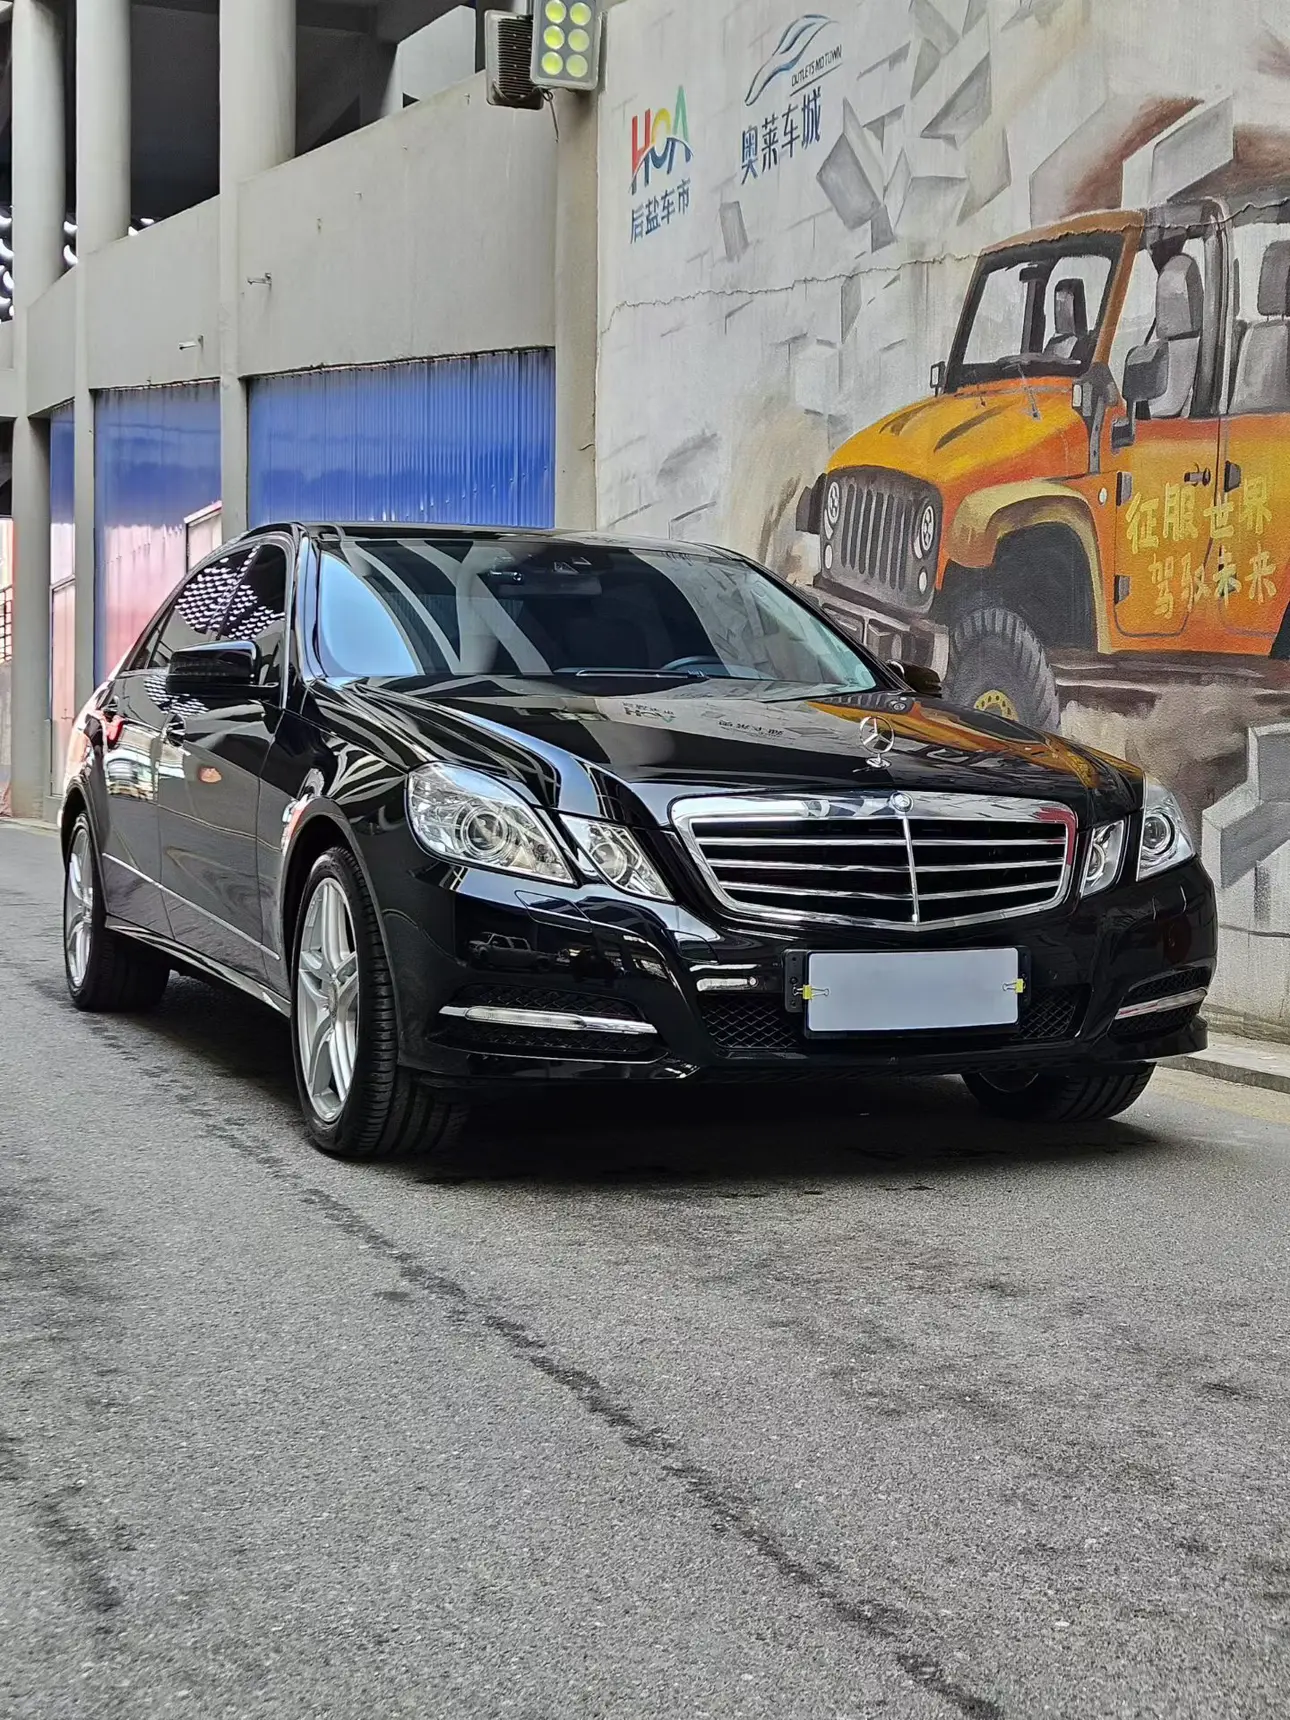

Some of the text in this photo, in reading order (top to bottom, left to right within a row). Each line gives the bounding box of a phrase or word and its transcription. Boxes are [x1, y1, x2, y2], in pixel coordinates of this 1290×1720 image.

[741, 86, 821, 185] 奥莱车城
[630, 178, 690, 244] 后盐车市
[1125, 476, 1272, 554] 征服世界
[1148, 541, 1277, 619] 驾驭未来
